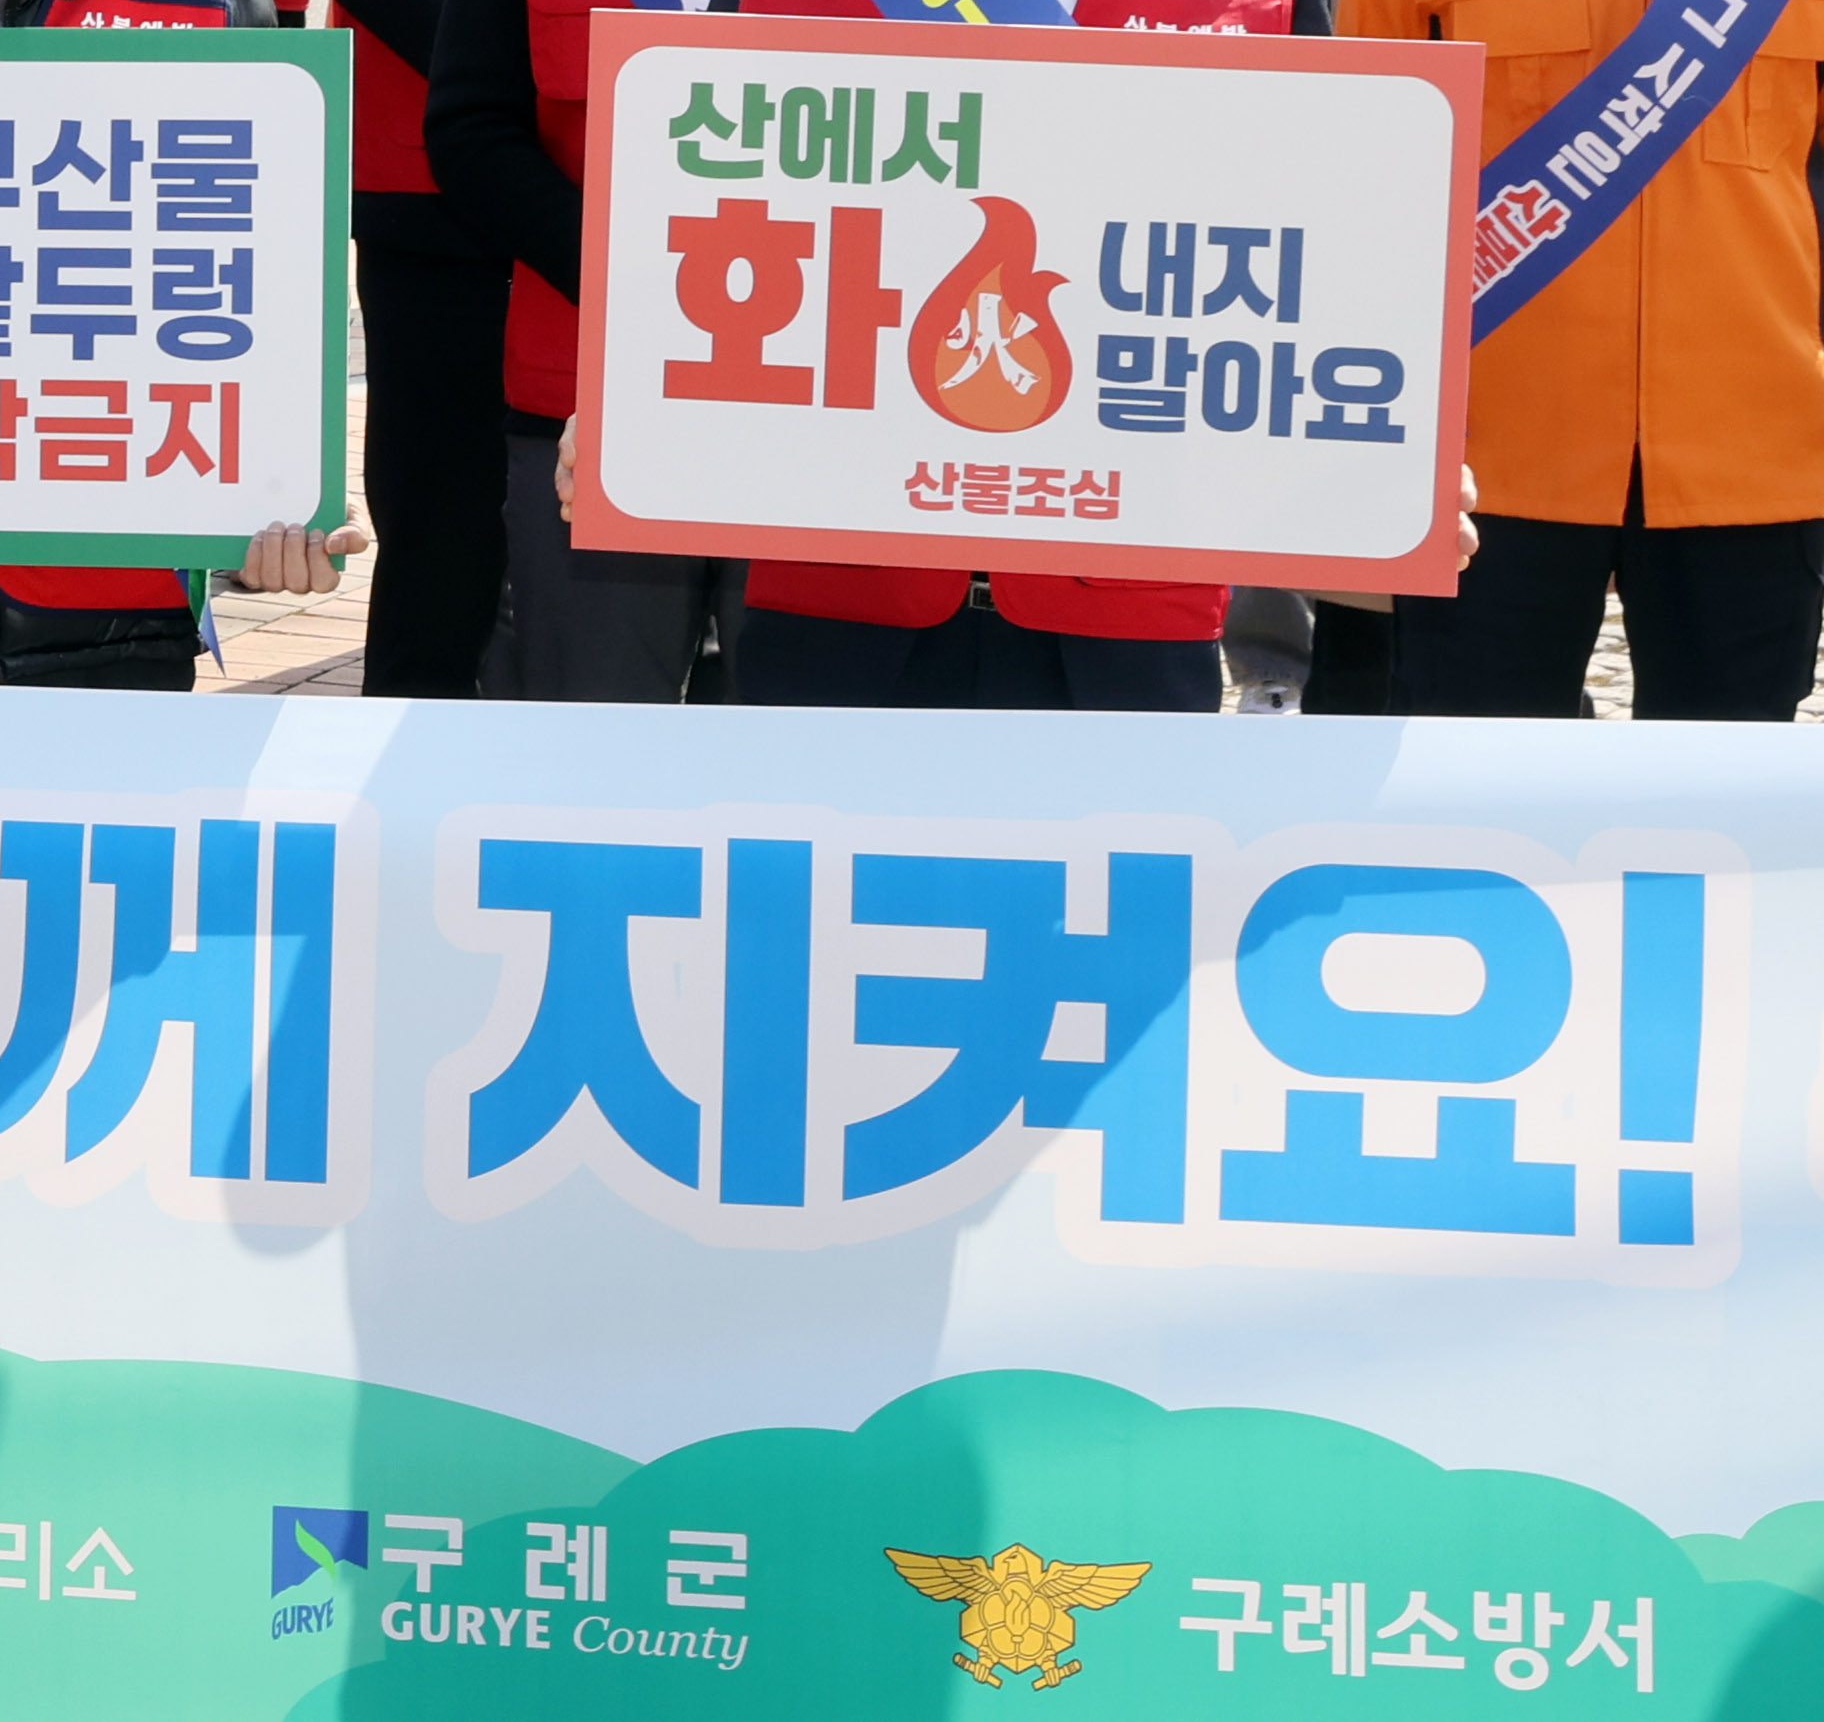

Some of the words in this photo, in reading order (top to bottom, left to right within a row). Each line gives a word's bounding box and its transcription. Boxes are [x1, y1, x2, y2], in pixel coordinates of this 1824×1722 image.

[668, 81, 983, 190] 산에서
[662, 198, 903, 410] 화
[1099, 221, 1304, 324] 내지
[1096, 333, 1406, 444] 말아요
[904, 461, 1121, 520] 산불조심
[467, 837, 1706, 1248] 지켜요!
[271, 1597, 334, 1641] GURYE
[381, 1601, 551, 1650] GURYE
[573, 1615, 749, 1671] County
[1178, 1576, 1655, 1694] 구례소방서
